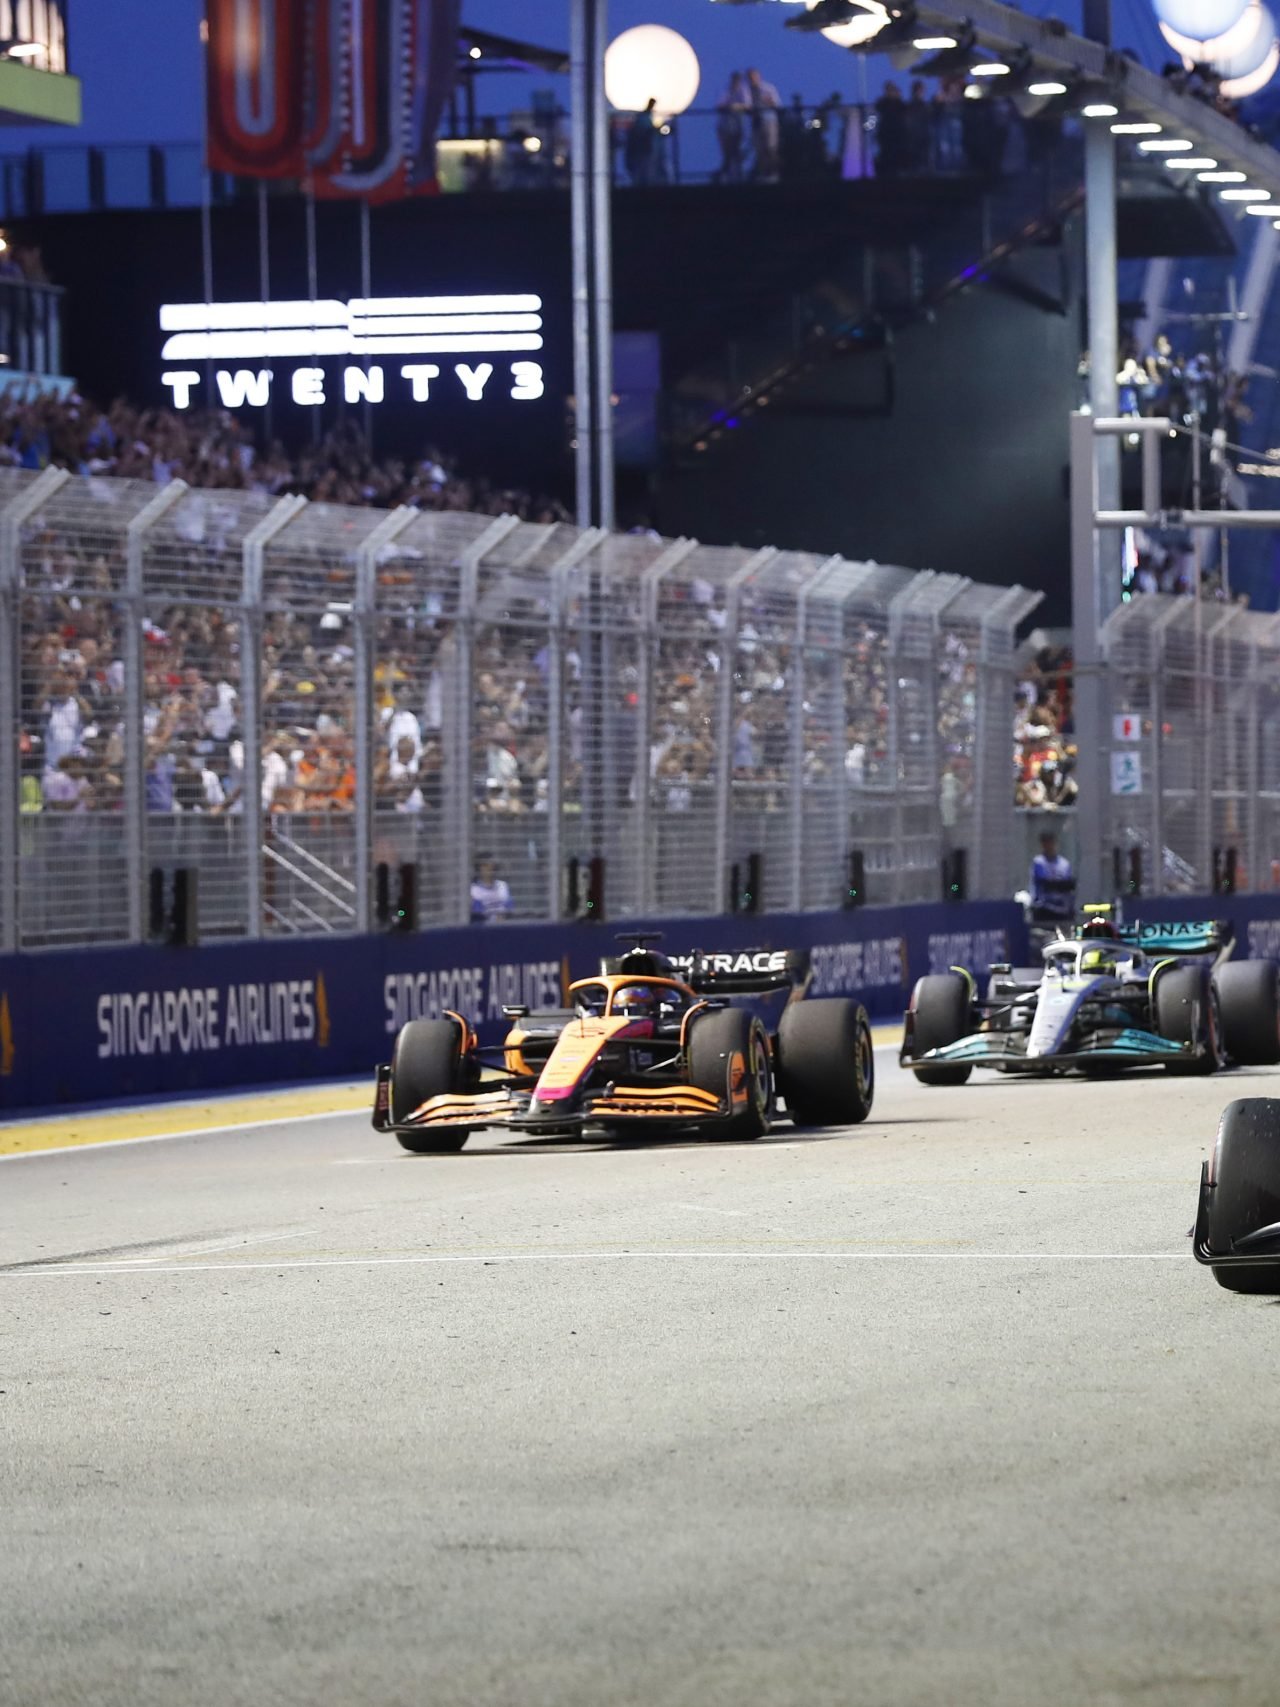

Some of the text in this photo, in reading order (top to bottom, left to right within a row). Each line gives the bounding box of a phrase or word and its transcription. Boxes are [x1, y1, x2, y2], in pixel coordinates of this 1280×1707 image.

[161, 361, 544, 410] TWENTY3
[97, 979, 315, 1057] SINGAPORE AIRLINES
